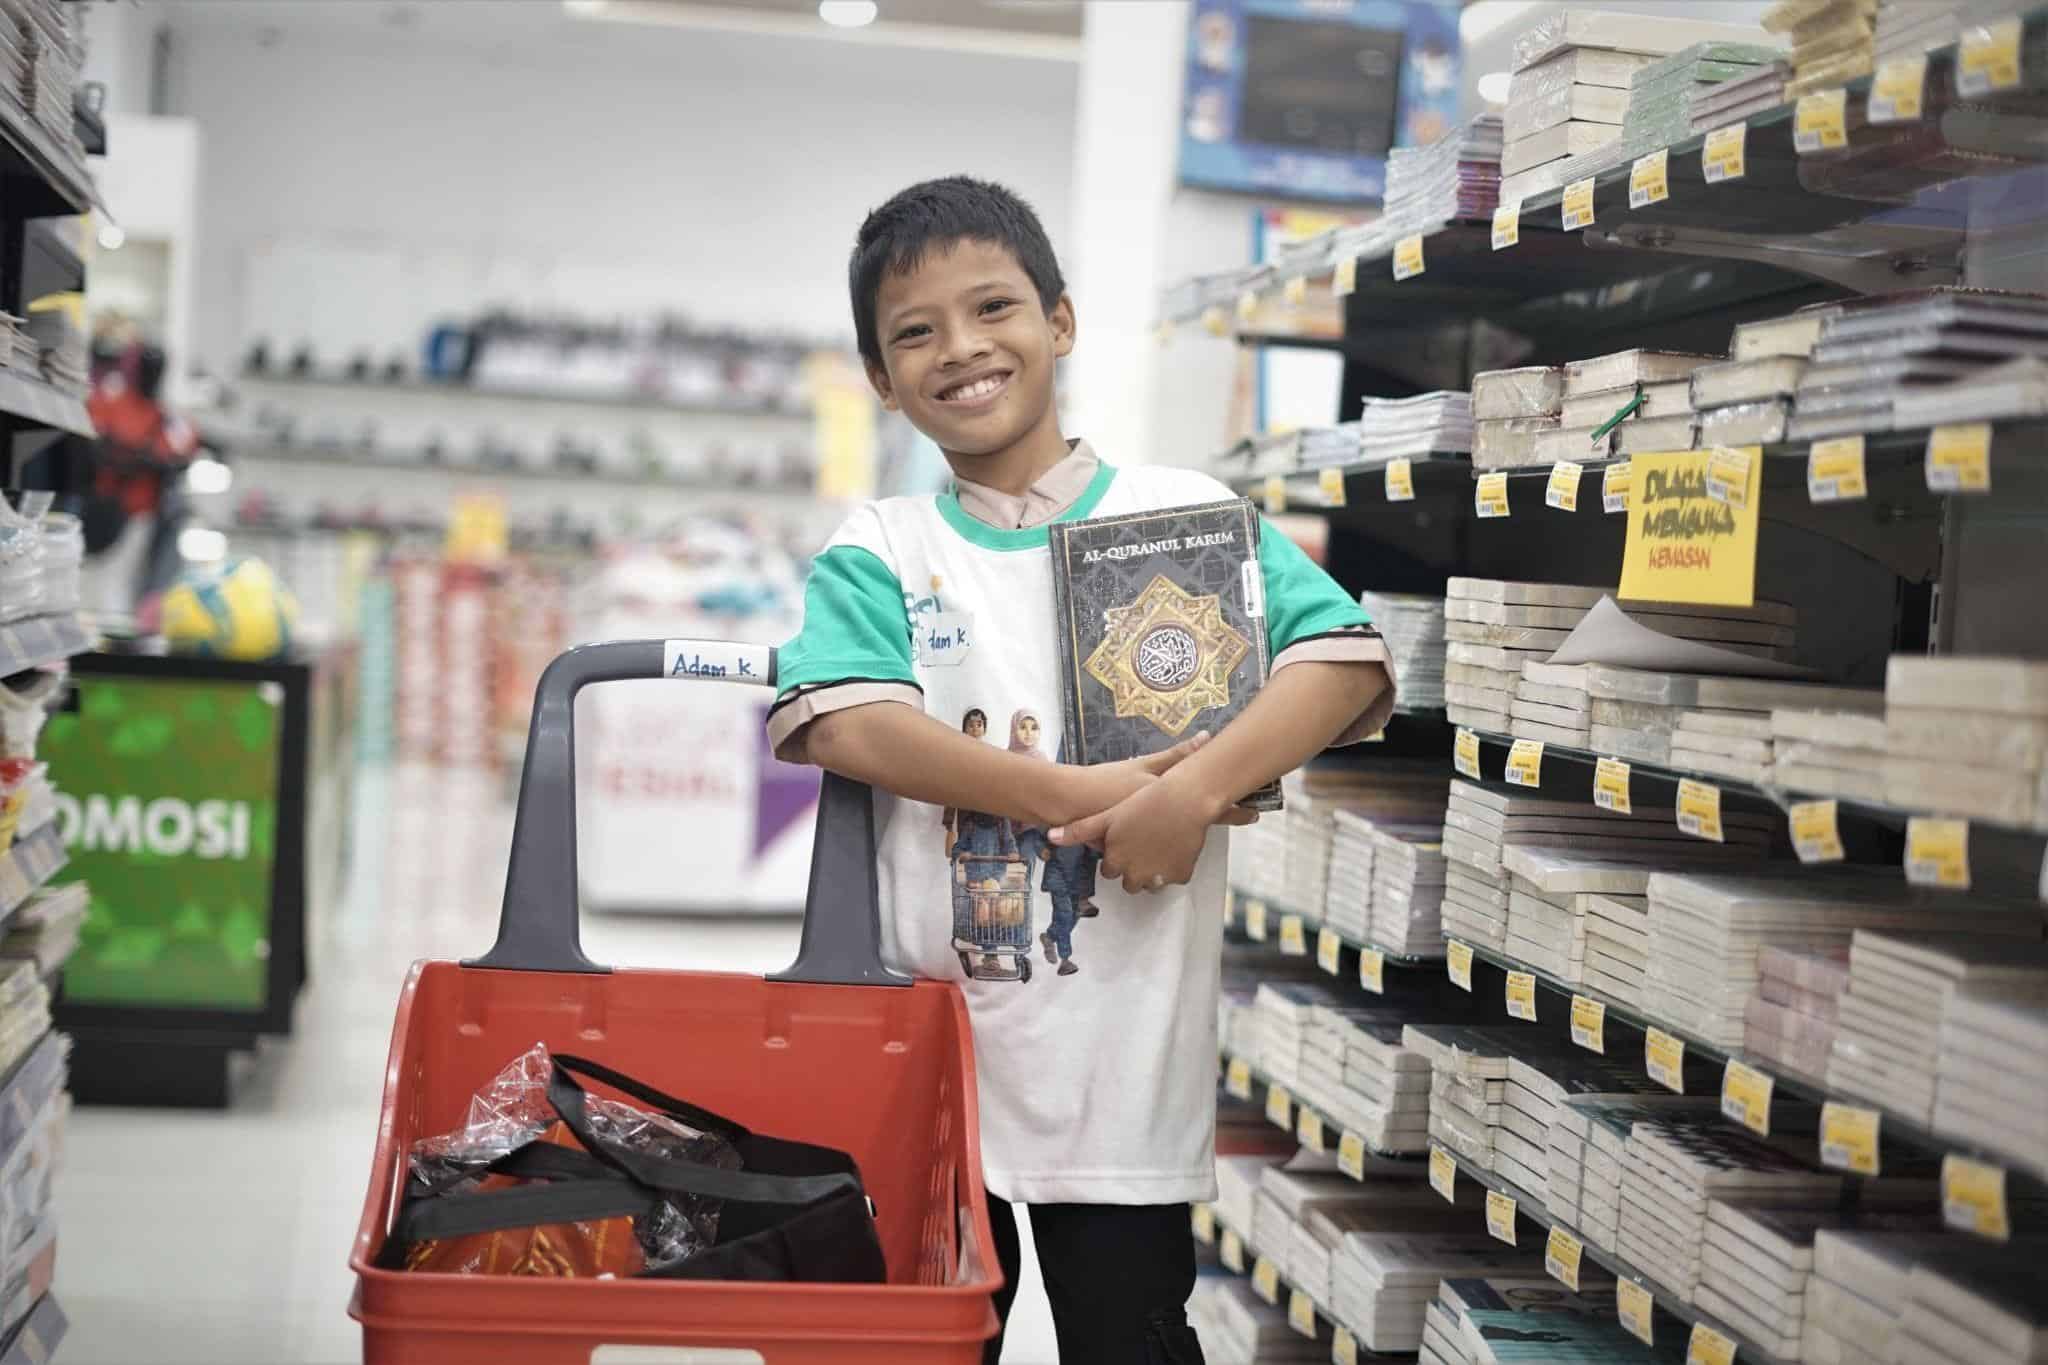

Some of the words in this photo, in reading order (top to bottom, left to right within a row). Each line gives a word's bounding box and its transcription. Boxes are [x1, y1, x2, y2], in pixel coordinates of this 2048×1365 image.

[1083, 539, 1181, 563] AL-QURANUL
[1186, 531, 1235, 550] KARIM
[672, 653, 726, 677] Adam
[50, 792, 250, 861] OMOSI
